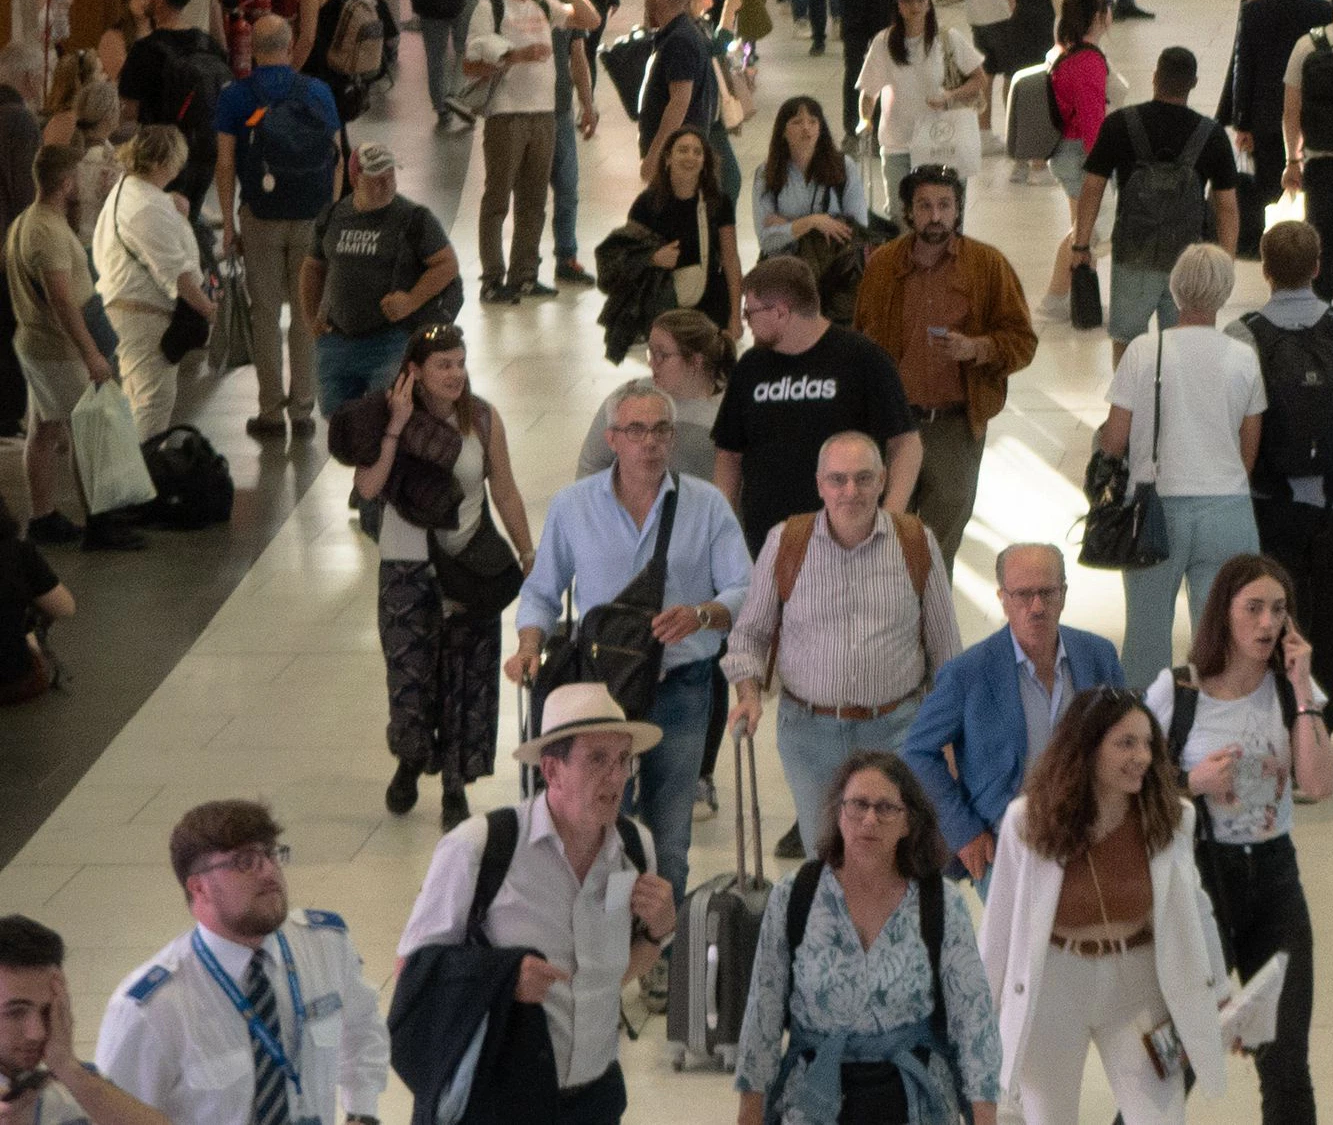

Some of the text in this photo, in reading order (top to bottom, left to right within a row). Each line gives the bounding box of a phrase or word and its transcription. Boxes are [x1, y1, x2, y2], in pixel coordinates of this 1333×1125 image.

[339, 229, 382, 241] TEDDY
[336, 242, 377, 256] SMITH
[753, 375, 837, 402] adidas
